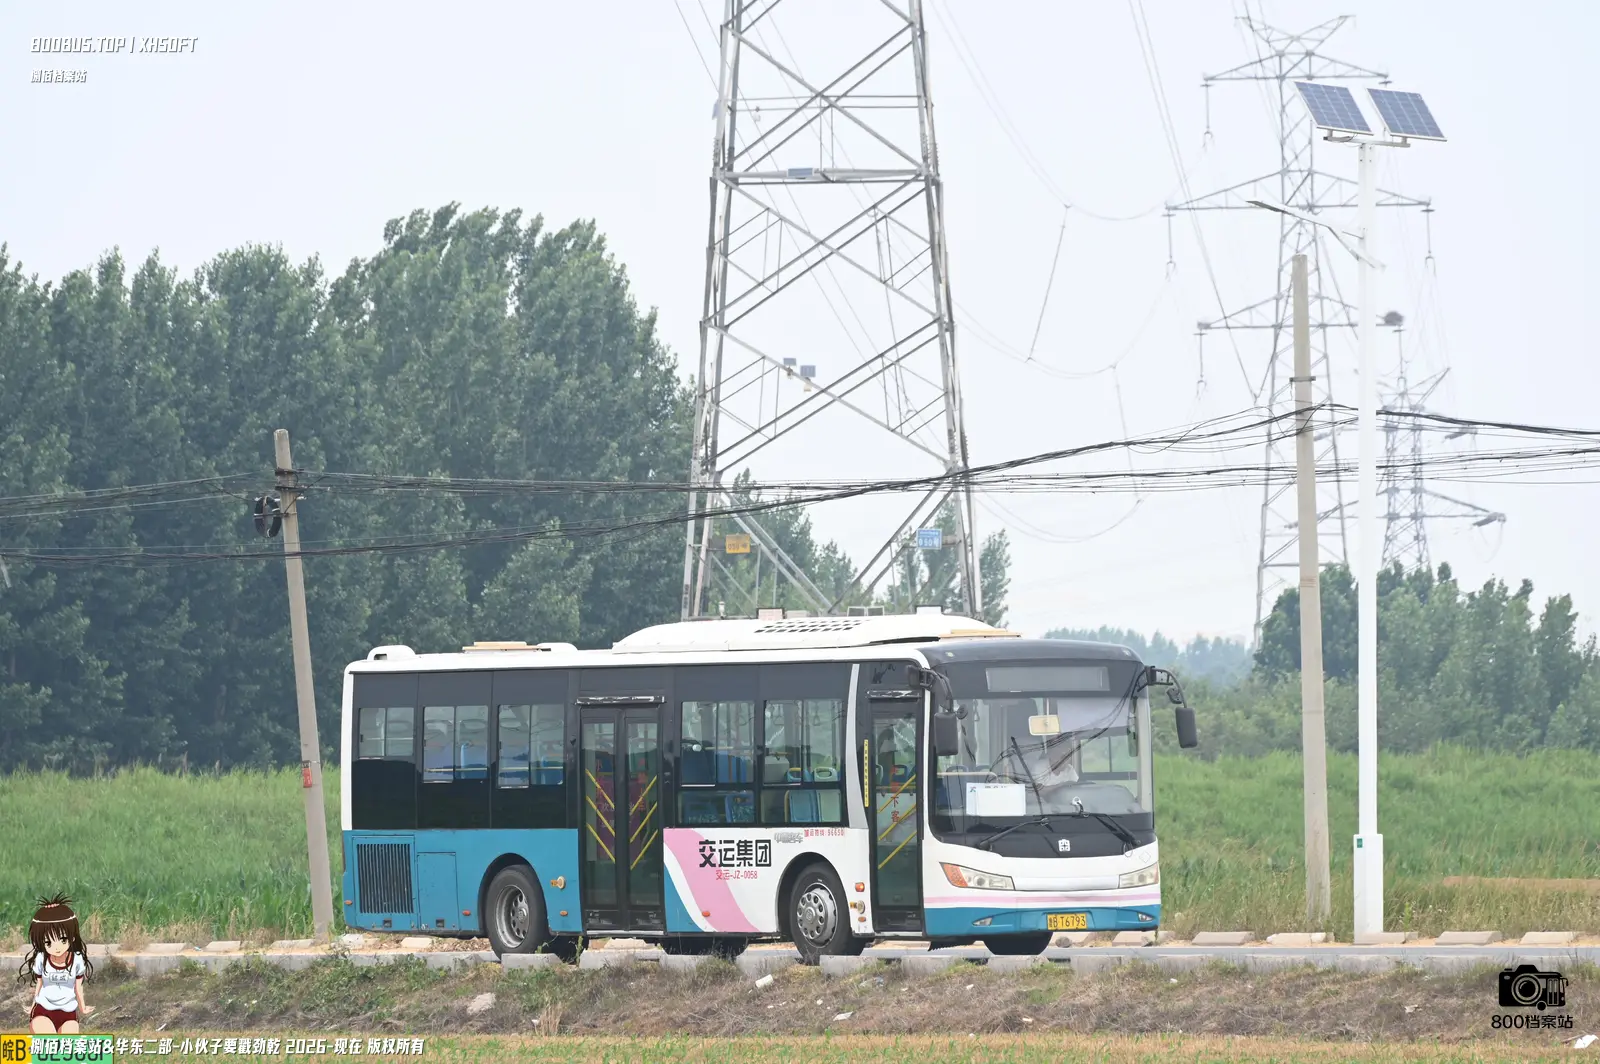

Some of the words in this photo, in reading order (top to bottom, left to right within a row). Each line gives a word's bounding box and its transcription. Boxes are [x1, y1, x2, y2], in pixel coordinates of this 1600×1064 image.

[699, 839, 772, 867] 交运集团
[1060, 915, 1086, 927] T6793
